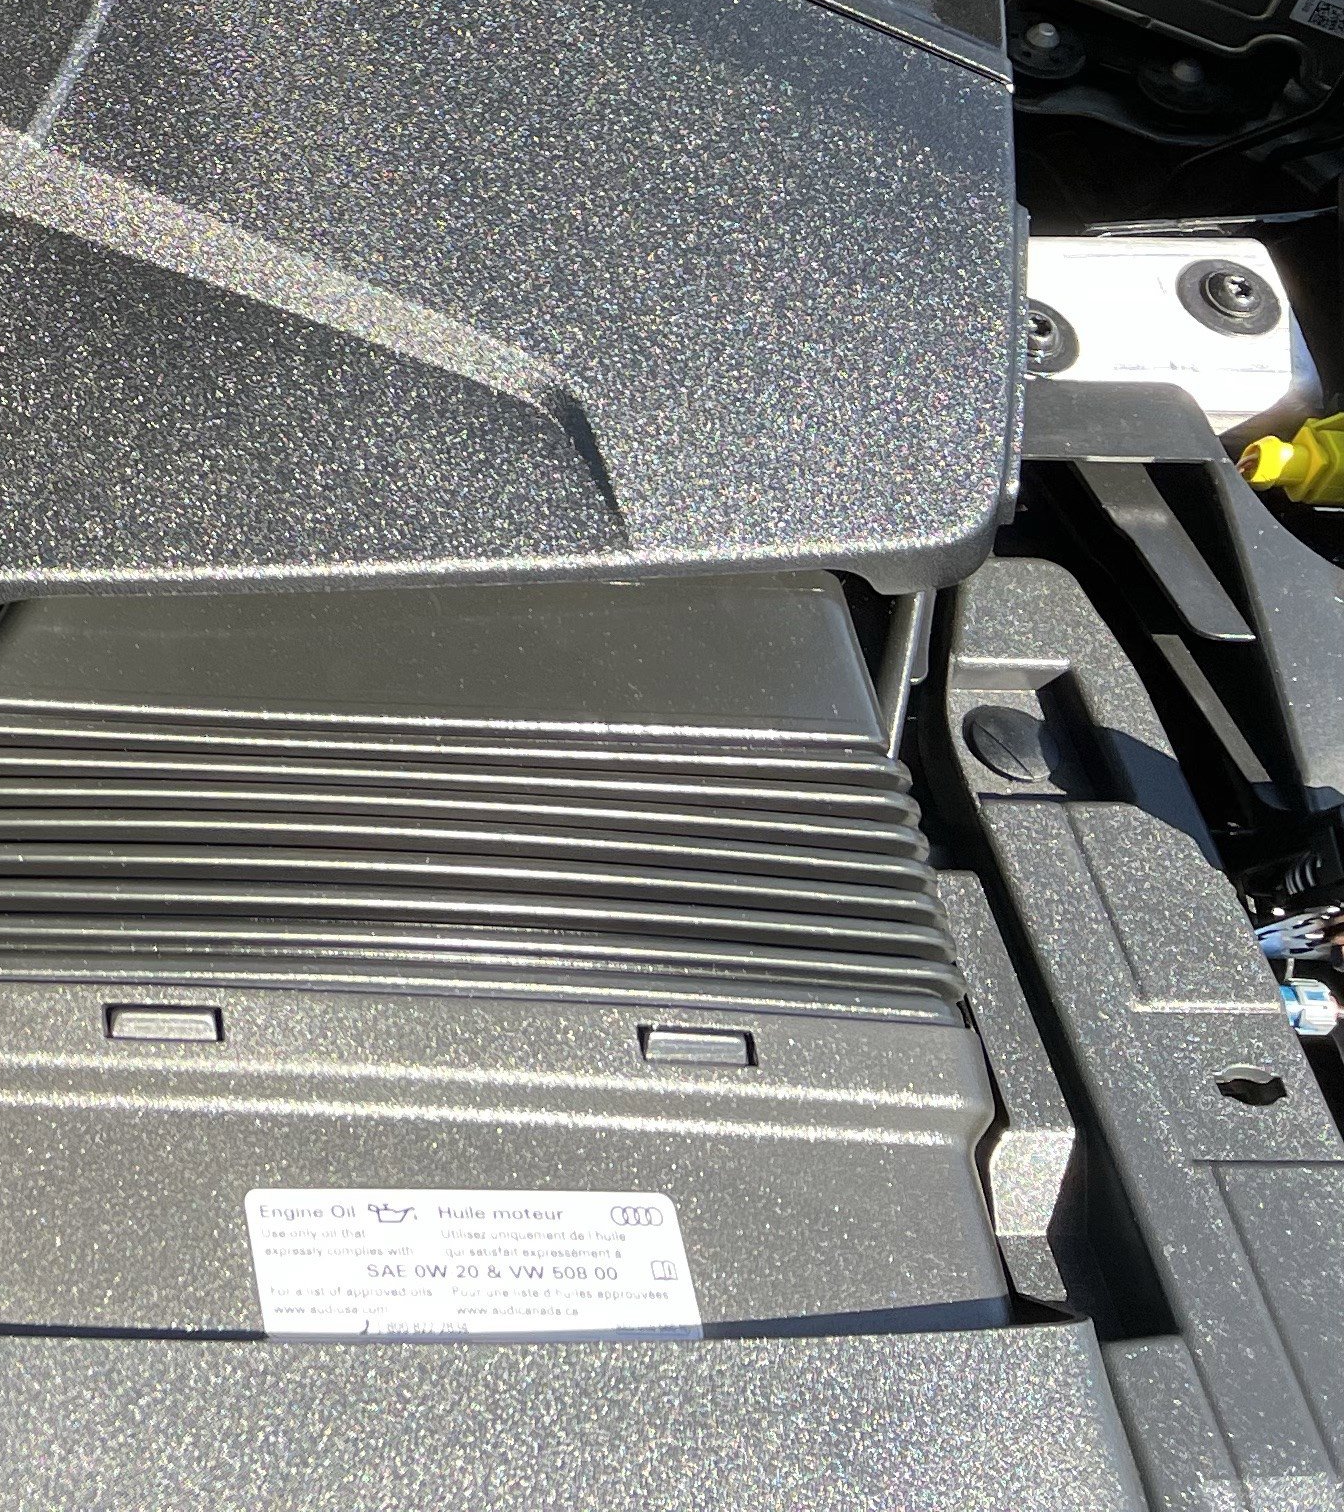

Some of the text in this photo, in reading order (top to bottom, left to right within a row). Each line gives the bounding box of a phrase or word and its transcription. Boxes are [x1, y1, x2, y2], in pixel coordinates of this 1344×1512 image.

[259, 1205, 355, 1220] Engine Oil
[439, 1206, 563, 1221] Huile moteur
[261, 1229, 366, 1240] Use only oil that
[491, 1231, 566, 1241] uniquement
[569, 1231, 584, 1241] de
[265, 1247, 414, 1257] expressly complies with
[446, 1249, 464, 1258] qui
[469, 1247, 517, 1257] satisfait
[614, 1249, 622, 1258] à
[367, 1264, 407, 1278] SAE
[487, 1265, 501, 1279] &
[509, 1265, 544, 1279] VW
[553, 1266, 587, 1280] 508
[594, 1266, 618, 1280] 00
[330, 1286, 341, 1296] of
[347, 1287, 406, 1298] approved
[411, 1288, 432, 1297] oils
[452, 1286, 481, 1297] Pour
[486, 1289, 509, 1297] une
[597, 1290, 669, 1300] approuvées
